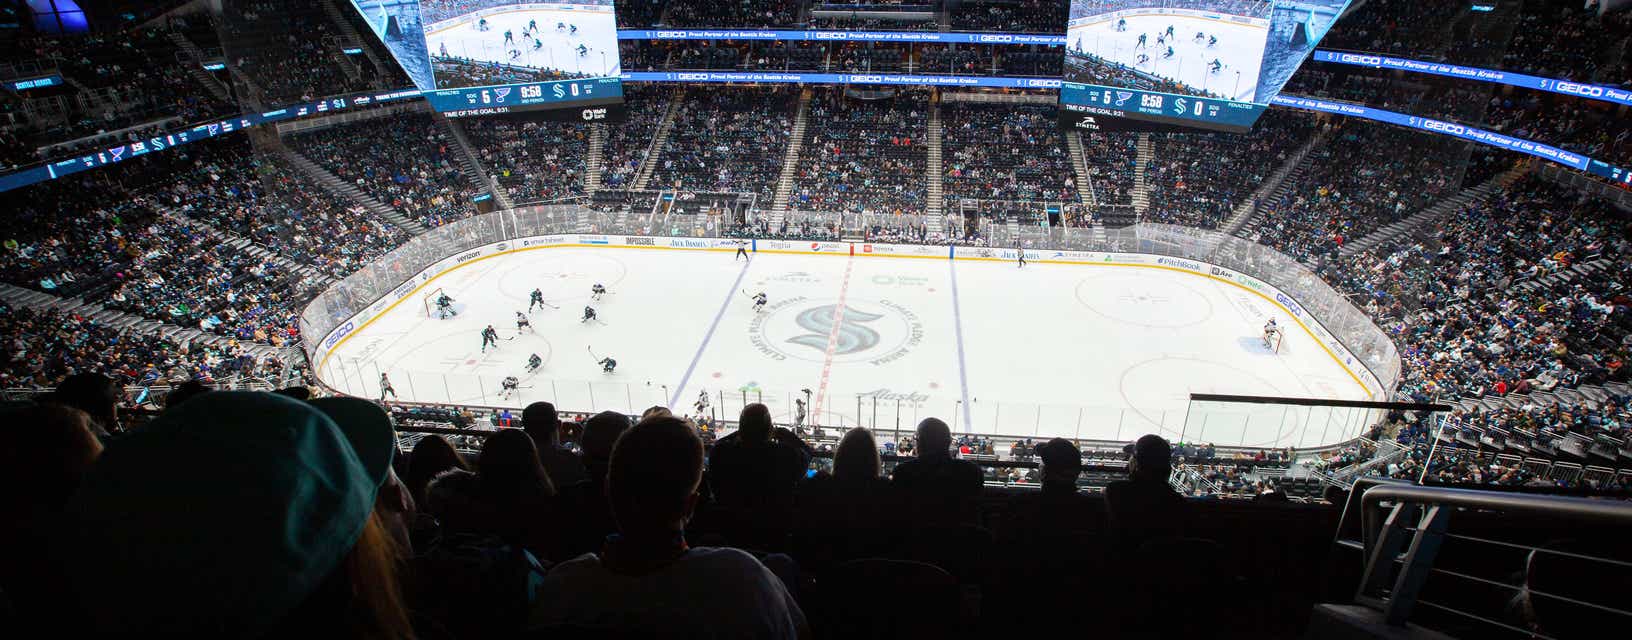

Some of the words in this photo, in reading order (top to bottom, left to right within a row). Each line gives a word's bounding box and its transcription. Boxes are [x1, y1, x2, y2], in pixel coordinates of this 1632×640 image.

[1342, 54, 1380, 65] GEICO
[1384, 58, 1402, 66] Proud
[1404, 60, 1430, 69] Partner
[1451, 66, 1476, 76] Seattle
[1477, 70, 1504, 79] Kraken
[482, 90, 490, 104] 5
[521, 86, 542, 98] 9:58
[571, 83, 579, 97] 0
[1556, 82, 1602, 97] GEICO
[1605, 91, 1628, 100] Proud
[1104, 90, 1111, 104] 5
[1141, 94, 1163, 108] 9:58
[1194, 101, 1203, 116] 0
[1424, 119, 1464, 134] GEICO
[1466, 128, 1486, 140] Proud
[1486, 133, 1512, 146] Partner
[1520, 142, 1534, 150] the
[1534, 145, 1558, 157] Seattle
[1558, 152, 1580, 164] Kraken
[626, 238, 656, 246] IMPOSSIBLE
[456, 250, 480, 264] verizon
[1164, 258, 1200, 272] PitchBook
[1276, 293, 1302, 317] GEICO
[326, 322, 354, 349] GEICO
